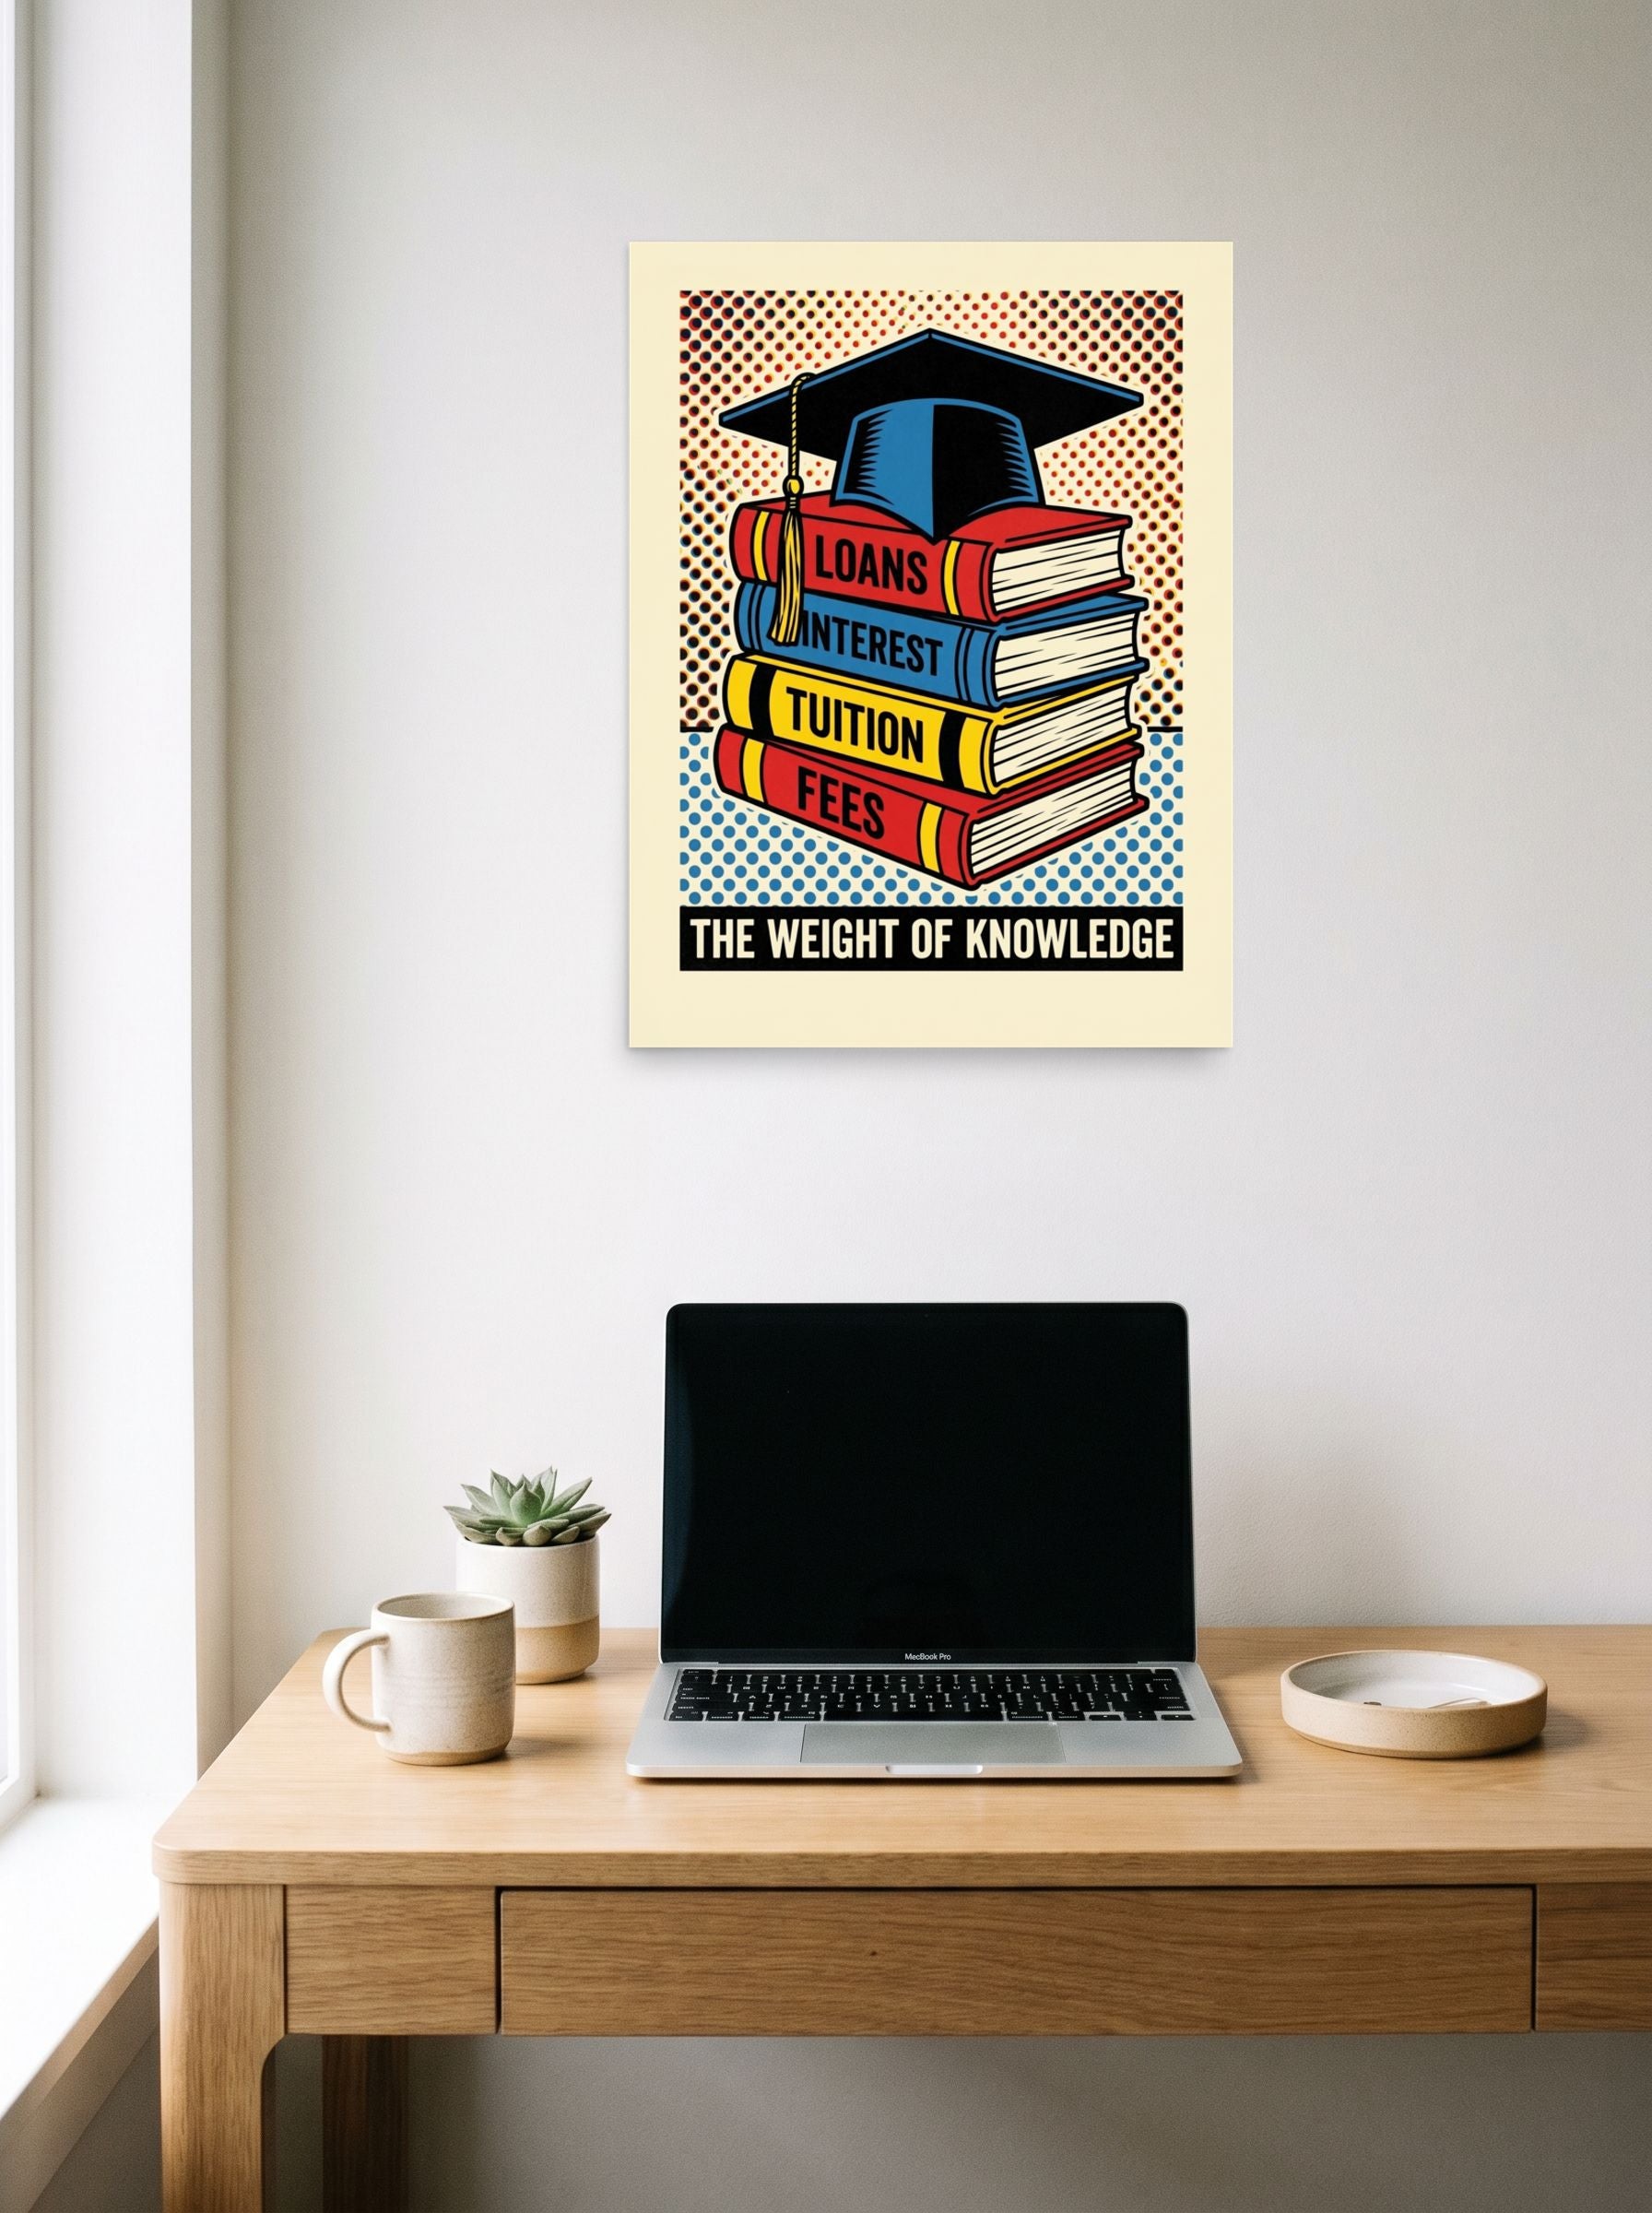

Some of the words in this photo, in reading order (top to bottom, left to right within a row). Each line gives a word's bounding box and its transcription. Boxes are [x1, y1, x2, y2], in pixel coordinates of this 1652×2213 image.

[816, 535, 927, 595] LOANS
[800, 610, 944, 677] INTEREST
[786, 686, 924, 763] TUITION
[797, 765, 885, 840] FEES
[690, 918, 755, 959] THE
[767, 918, 900, 959] WEIGHT
[912, 917, 953, 959] OF
[966, 918, 1174, 959] KNOWLEDGE
[938, 1652, 952, 1661] Pro
